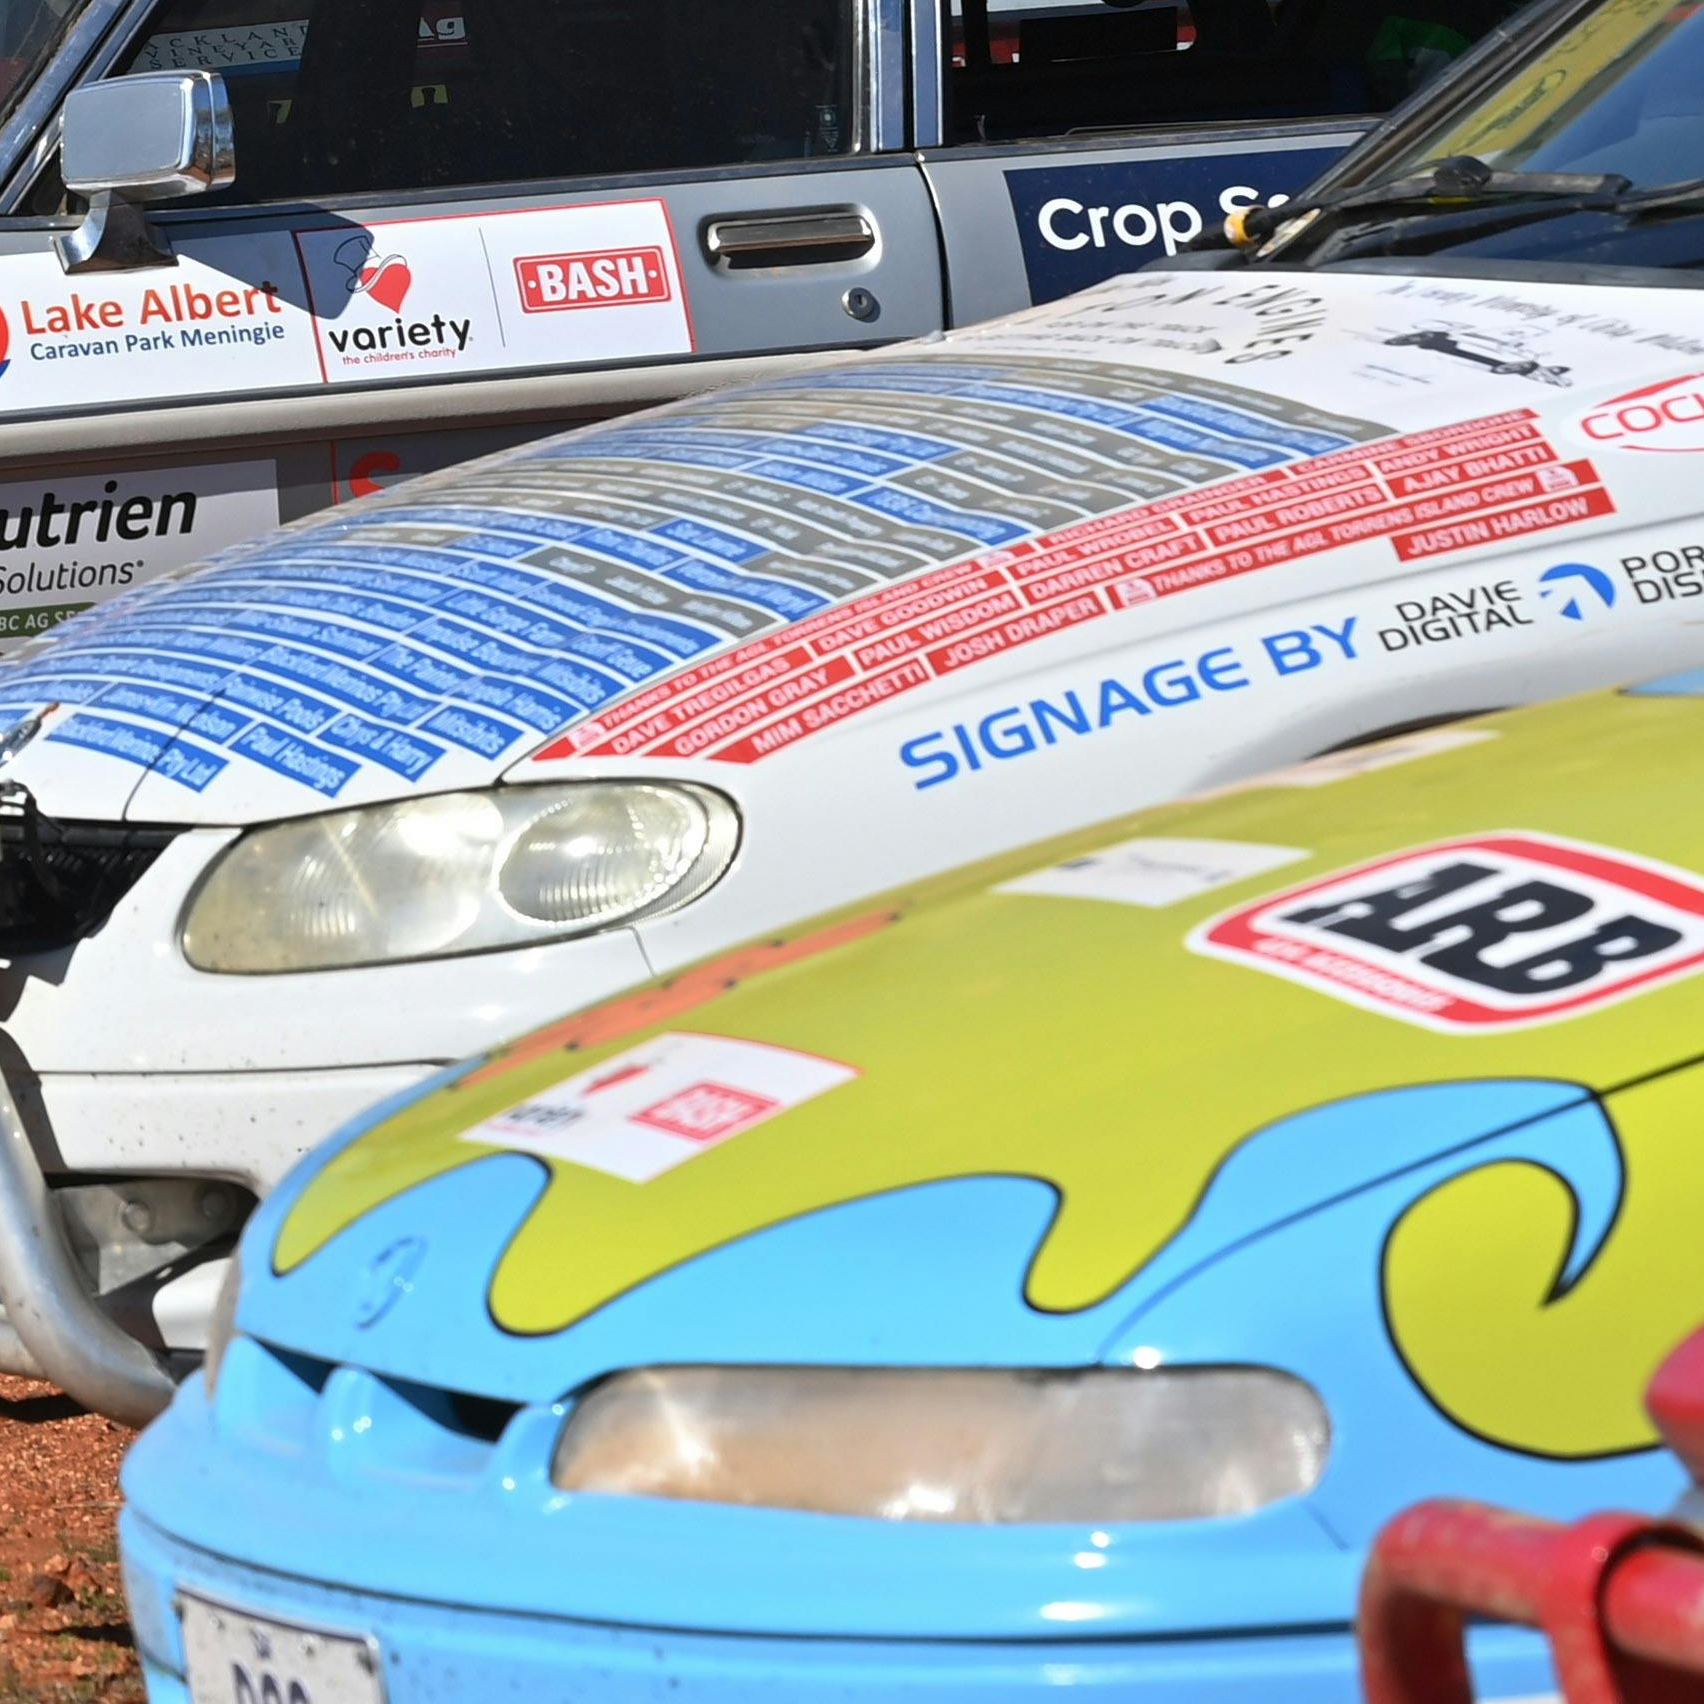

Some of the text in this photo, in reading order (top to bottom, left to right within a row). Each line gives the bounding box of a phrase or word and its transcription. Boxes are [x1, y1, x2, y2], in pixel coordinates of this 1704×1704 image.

[1037, 198, 1204, 276] Crop
[20, 280, 282, 336] Lake Albert
[536, 255, 650, 303] BASH
[30, 320, 285, 361] Caravan Park Meningie
[328, 312, 471, 352] variety
[342, 346, 457, 366] the children's charity
[1379, 423, 1535, 474] ANDY WRIGHT
[1403, 444, 1548, 492] AJAY BHATTI
[1189, 465, 1369, 523] PAUL HASTINGS
[1214, 485, 1381, 543] PAUL ROBERTS
[1015, 520, 1171, 576] PAUL WROBEL
[1153, 478, 1536, 594] THANKS TO THE AGL TORRENS ISLAND CREW
[1405, 497, 1591, 558] JUSTIN HARLOW
[1030, 535, 1199, 599] DARREN CRAFT
[24, 612, 49, 631] AG
[818, 578, 988, 653] DAVE GOODWIN
[858, 592, 1016, 667] PAUL WISDOM
[1378, 603, 1535, 654] DIGITAL
[1395, 579, 1522, 624] DAVIE
[943, 597, 1099, 668] JOSH DRAPER
[611, 657, 791, 755] DAVE TREGILGAS
[673, 669, 830, 756] GORDON GRAY
[751, 662, 926, 755] MIM SACCHETTI
[897, 614, 1361, 792] SIGNAGE BY
[1276, 862, 1684, 996] ARB
